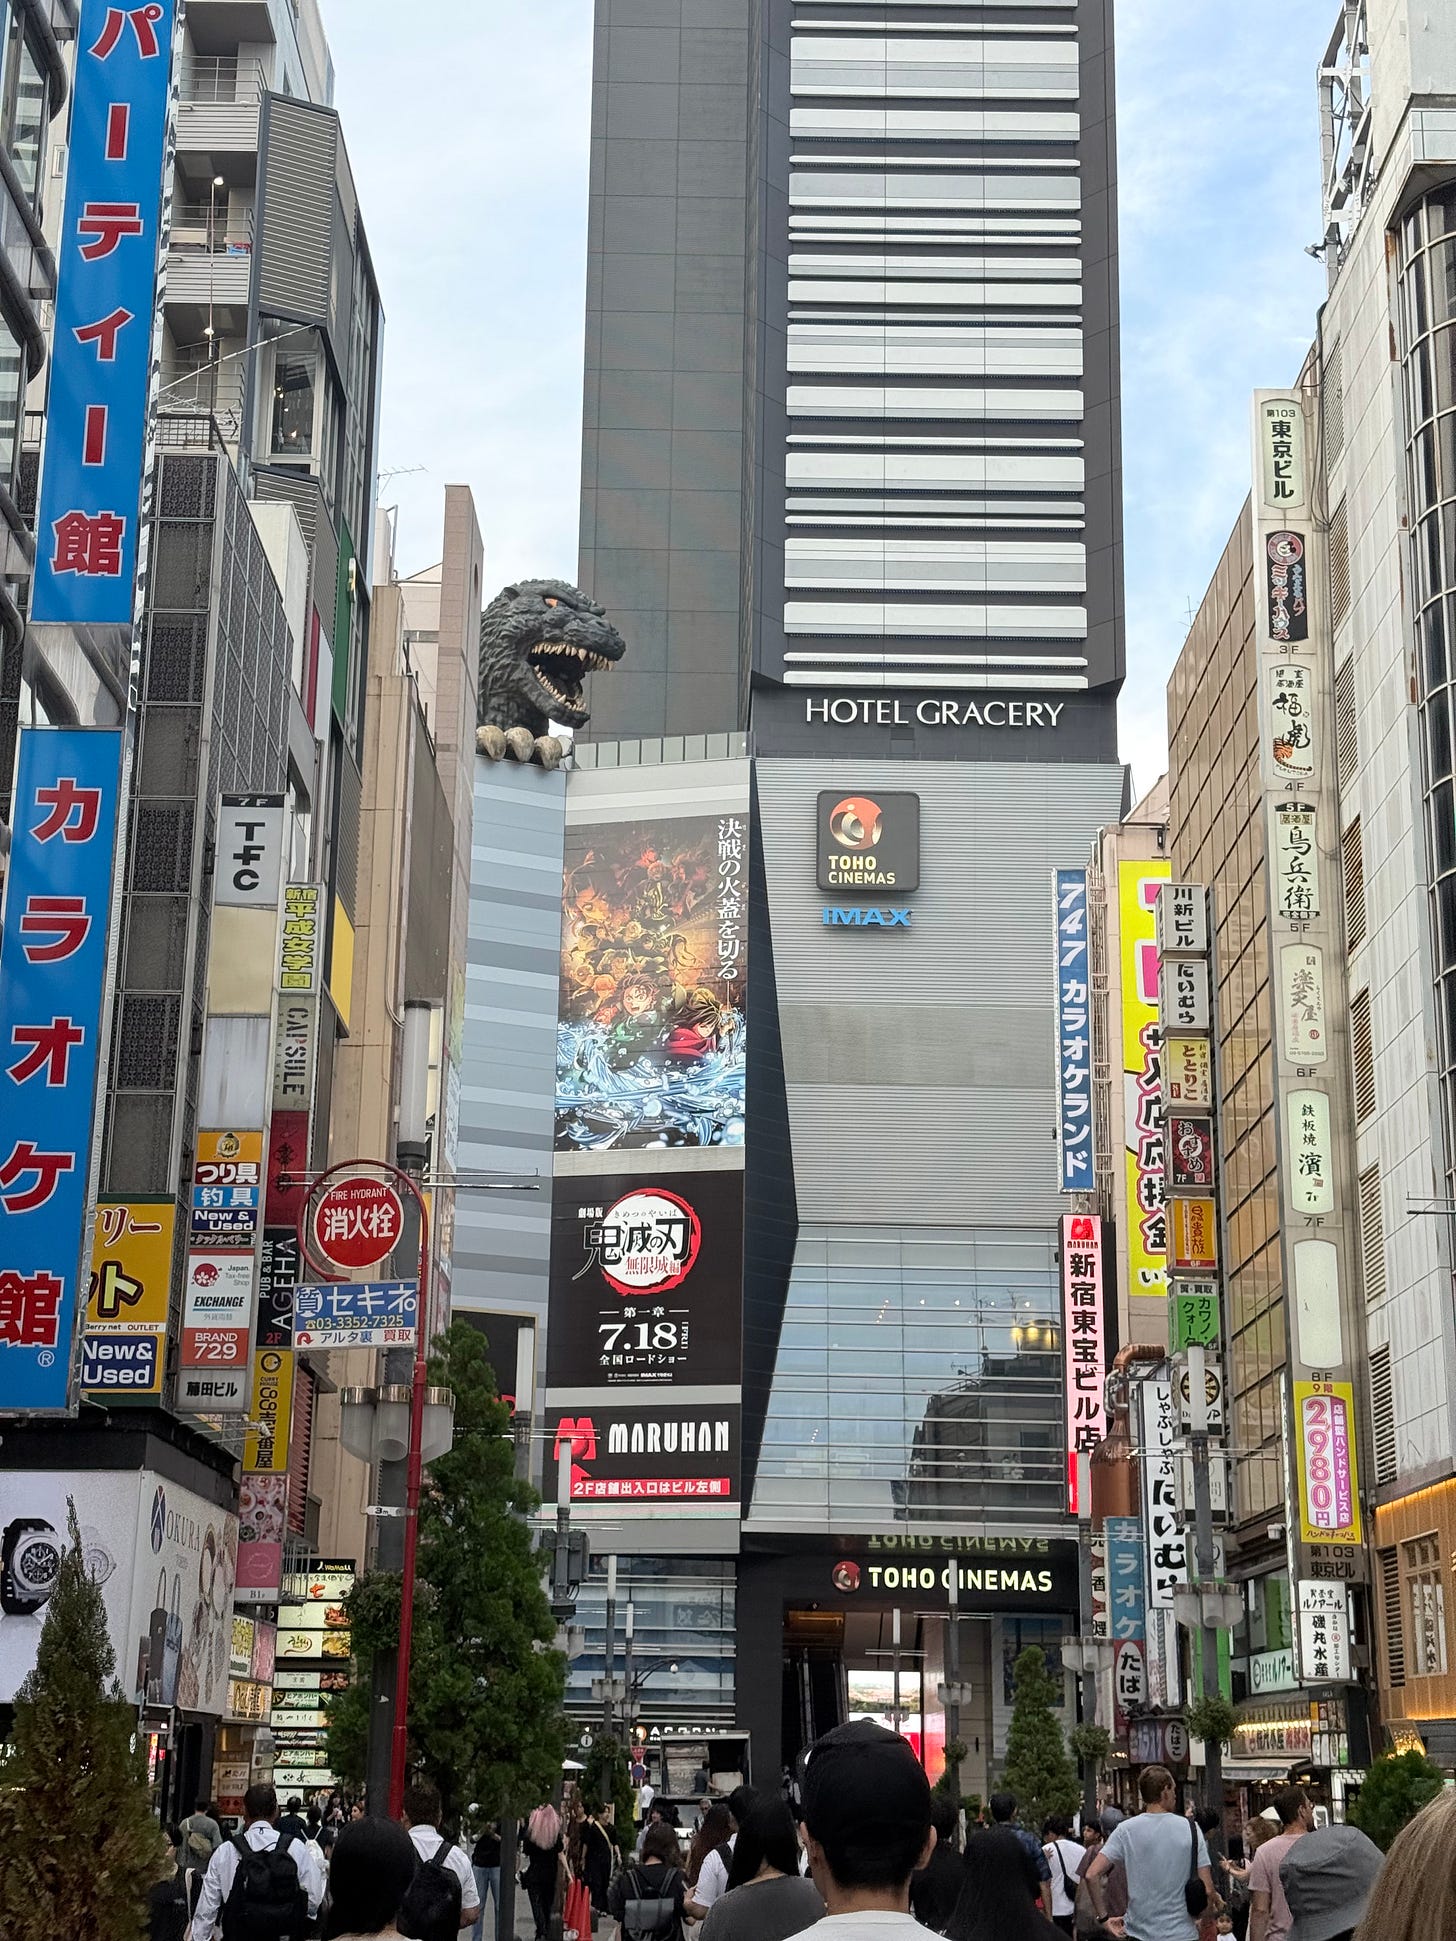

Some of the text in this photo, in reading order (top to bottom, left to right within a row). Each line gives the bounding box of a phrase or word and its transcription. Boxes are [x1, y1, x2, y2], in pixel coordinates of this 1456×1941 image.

[50, 2, 164, 578] パーティー館
[1271, 420, 1295, 499] 東京ビル
[805, 698, 1065, 727] HOTEL GRACERY
[828, 855, 877, 870] TOHO
[828, 871, 896, 885] CINEMAS
[717, 818, 742, 981] 決戦の火蓋を切る
[822, 906, 912, 927] IMAX
[1173, 888, 1195, 947] 川新ビル
[1177, 963, 1196, 1025] にいむら
[1059, 883, 1090, 1178] 747 カラオケランド
[282, 1007, 309, 1095] CAPSULE
[0, 776, 102, 1348] カラオケ館
[1183, 1045, 1198, 1101] ととりこ
[197, 1163, 258, 1184] つり具
[330, 1187, 388, 1201] FIRE HYDRANT
[195, 1210, 250, 1221] New &
[209, 1221, 254, 1231] Used
[323, 1202, 396, 1242] 消火栓
[95, 1206, 162, 1247] リー
[262, 1240, 274, 1263] BAR
[572, 1217, 692, 1281] 鬼滅の刃
[259, 1276, 272, 1298] PUB
[193, 1296, 246, 1308] EXCHANGE
[623, 1305, 665, 1318] 第一章
[127, 1324, 160, 1332] OUTLET
[316, 1315, 404, 1330] 03-3352-7325
[195, 1332, 238, 1342] BRAND
[265, 1332, 282, 1344] 2F
[321, 1330, 411, 1344] アルタ裏 買取
[597, 1321, 677, 1351] 7.18
[194, 1343, 238, 1360] 729
[599, 1353, 688, 1366] 全国ロードショー
[1070, 1252, 1101, 1453] 新宿東宝ビル店
[83, 1364, 151, 1385] Used
[186, 1381, 238, 1397] 藤田ビル
[608, 1421, 729, 1453] MARUHAN
[1157, 1386, 1175, 1475] しゃぶしゃぶ
[573, 1479, 722, 1495] 2F店舗出入口はビル左側
[1310, 1546, 1355, 1558] 第103
[868, 1566, 1053, 1592] TOHO CINEMAS
[1310, 1561, 1356, 1578] 東京ビル
[1114, 1521, 1144, 1641] カラオケ
[1303, 1598, 1343, 1610] ルノアール
[1311, 1615, 1330, 1677] 磯丸水産
